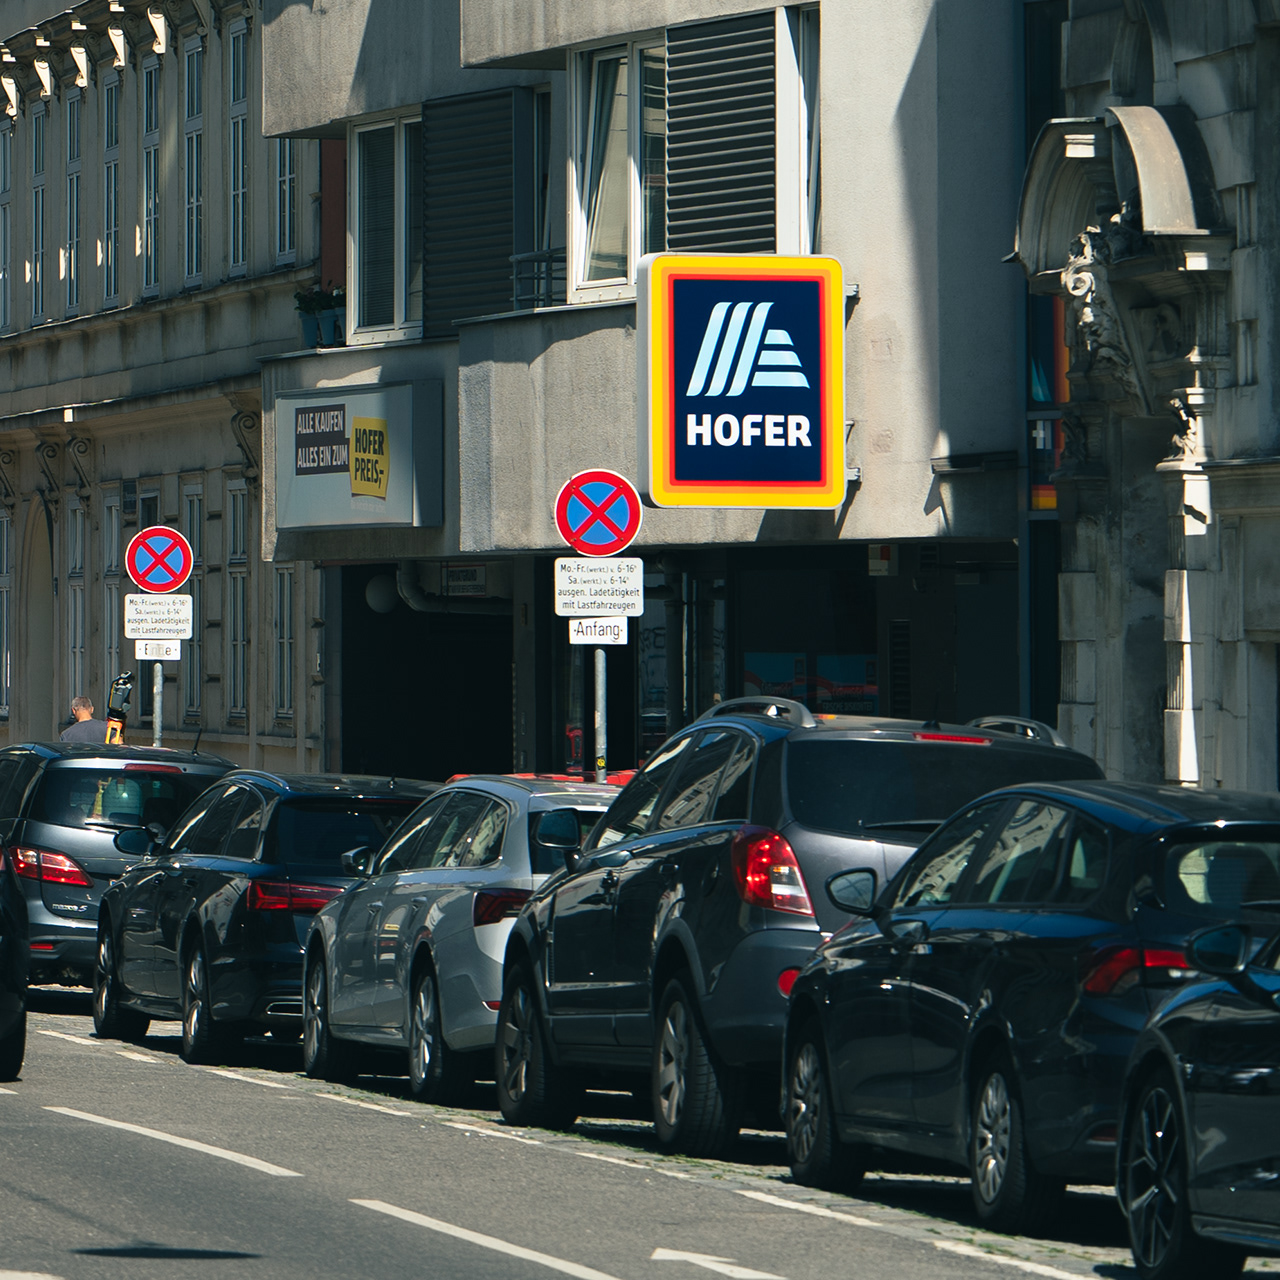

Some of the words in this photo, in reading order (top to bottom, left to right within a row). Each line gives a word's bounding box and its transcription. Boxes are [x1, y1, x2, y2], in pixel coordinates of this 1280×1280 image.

[297, 413, 314, 434] ALLE
[315, 410, 344, 433] KAUFEN
[686, 414, 812, 447] HOFER
[354, 428, 385, 456] HOFER
[297, 447, 318, 468] ALLES
[320, 446, 332, 467] EIN
[332, 444, 348, 465] ZUM
[558, 589, 587, 598] ausgen.
[589, 587, 640, 598] Ladetätigkeit
[562, 600, 575, 609] mit
[577, 600, 636, 611] Lastfahrzeugen
[130, 626, 140, 634] mit
[142, 627, 186, 635] Lastfahrzeugen
[151, 617, 190, 625] Ladetätigkeit
[575, 621, 621, 640] Anfang
